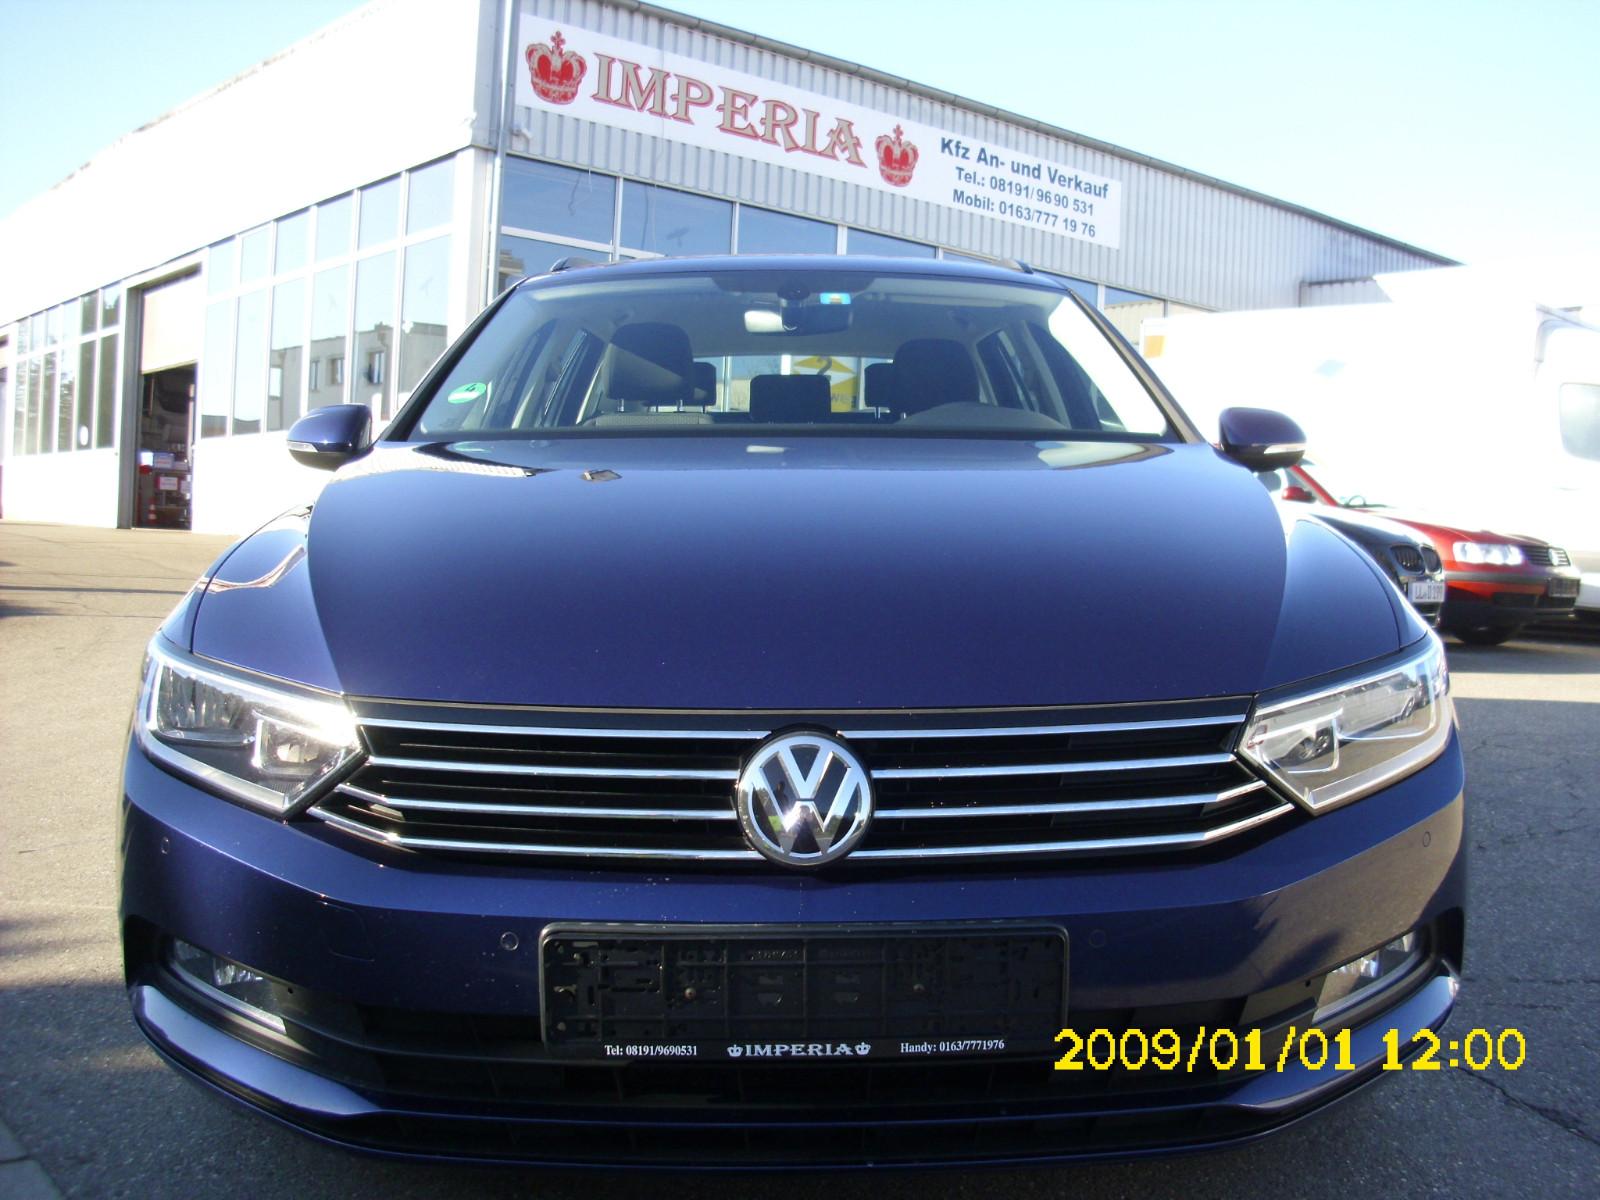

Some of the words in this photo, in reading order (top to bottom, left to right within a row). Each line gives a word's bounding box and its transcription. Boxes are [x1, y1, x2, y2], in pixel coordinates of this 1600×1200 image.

[590, 53, 868, 168] IMPERIA
[940, 137, 970, 160] Kfz
[976, 147, 1005, 169] An-
[1011, 160, 1042, 180] und
[1047, 166, 1109, 199] Verkauf
[955, 166, 985, 187] Tel.:
[1073, 199, 1094, 217] 531
[953, 189, 995, 212] Mobil:
[999, 201, 1059, 227] 0163/777
[1063, 217, 1077, 233] 19
[1081, 223, 1096, 238] 76
[604, 1045, 624, 1056] Tel:
[626, 1045, 697, 1056] 08191/9690531
[745, 1043, 853, 1057] IMPERIA
[900, 1042, 936, 1054] Handy:
[940, 1040, 1005, 1052] 0163/7771976
